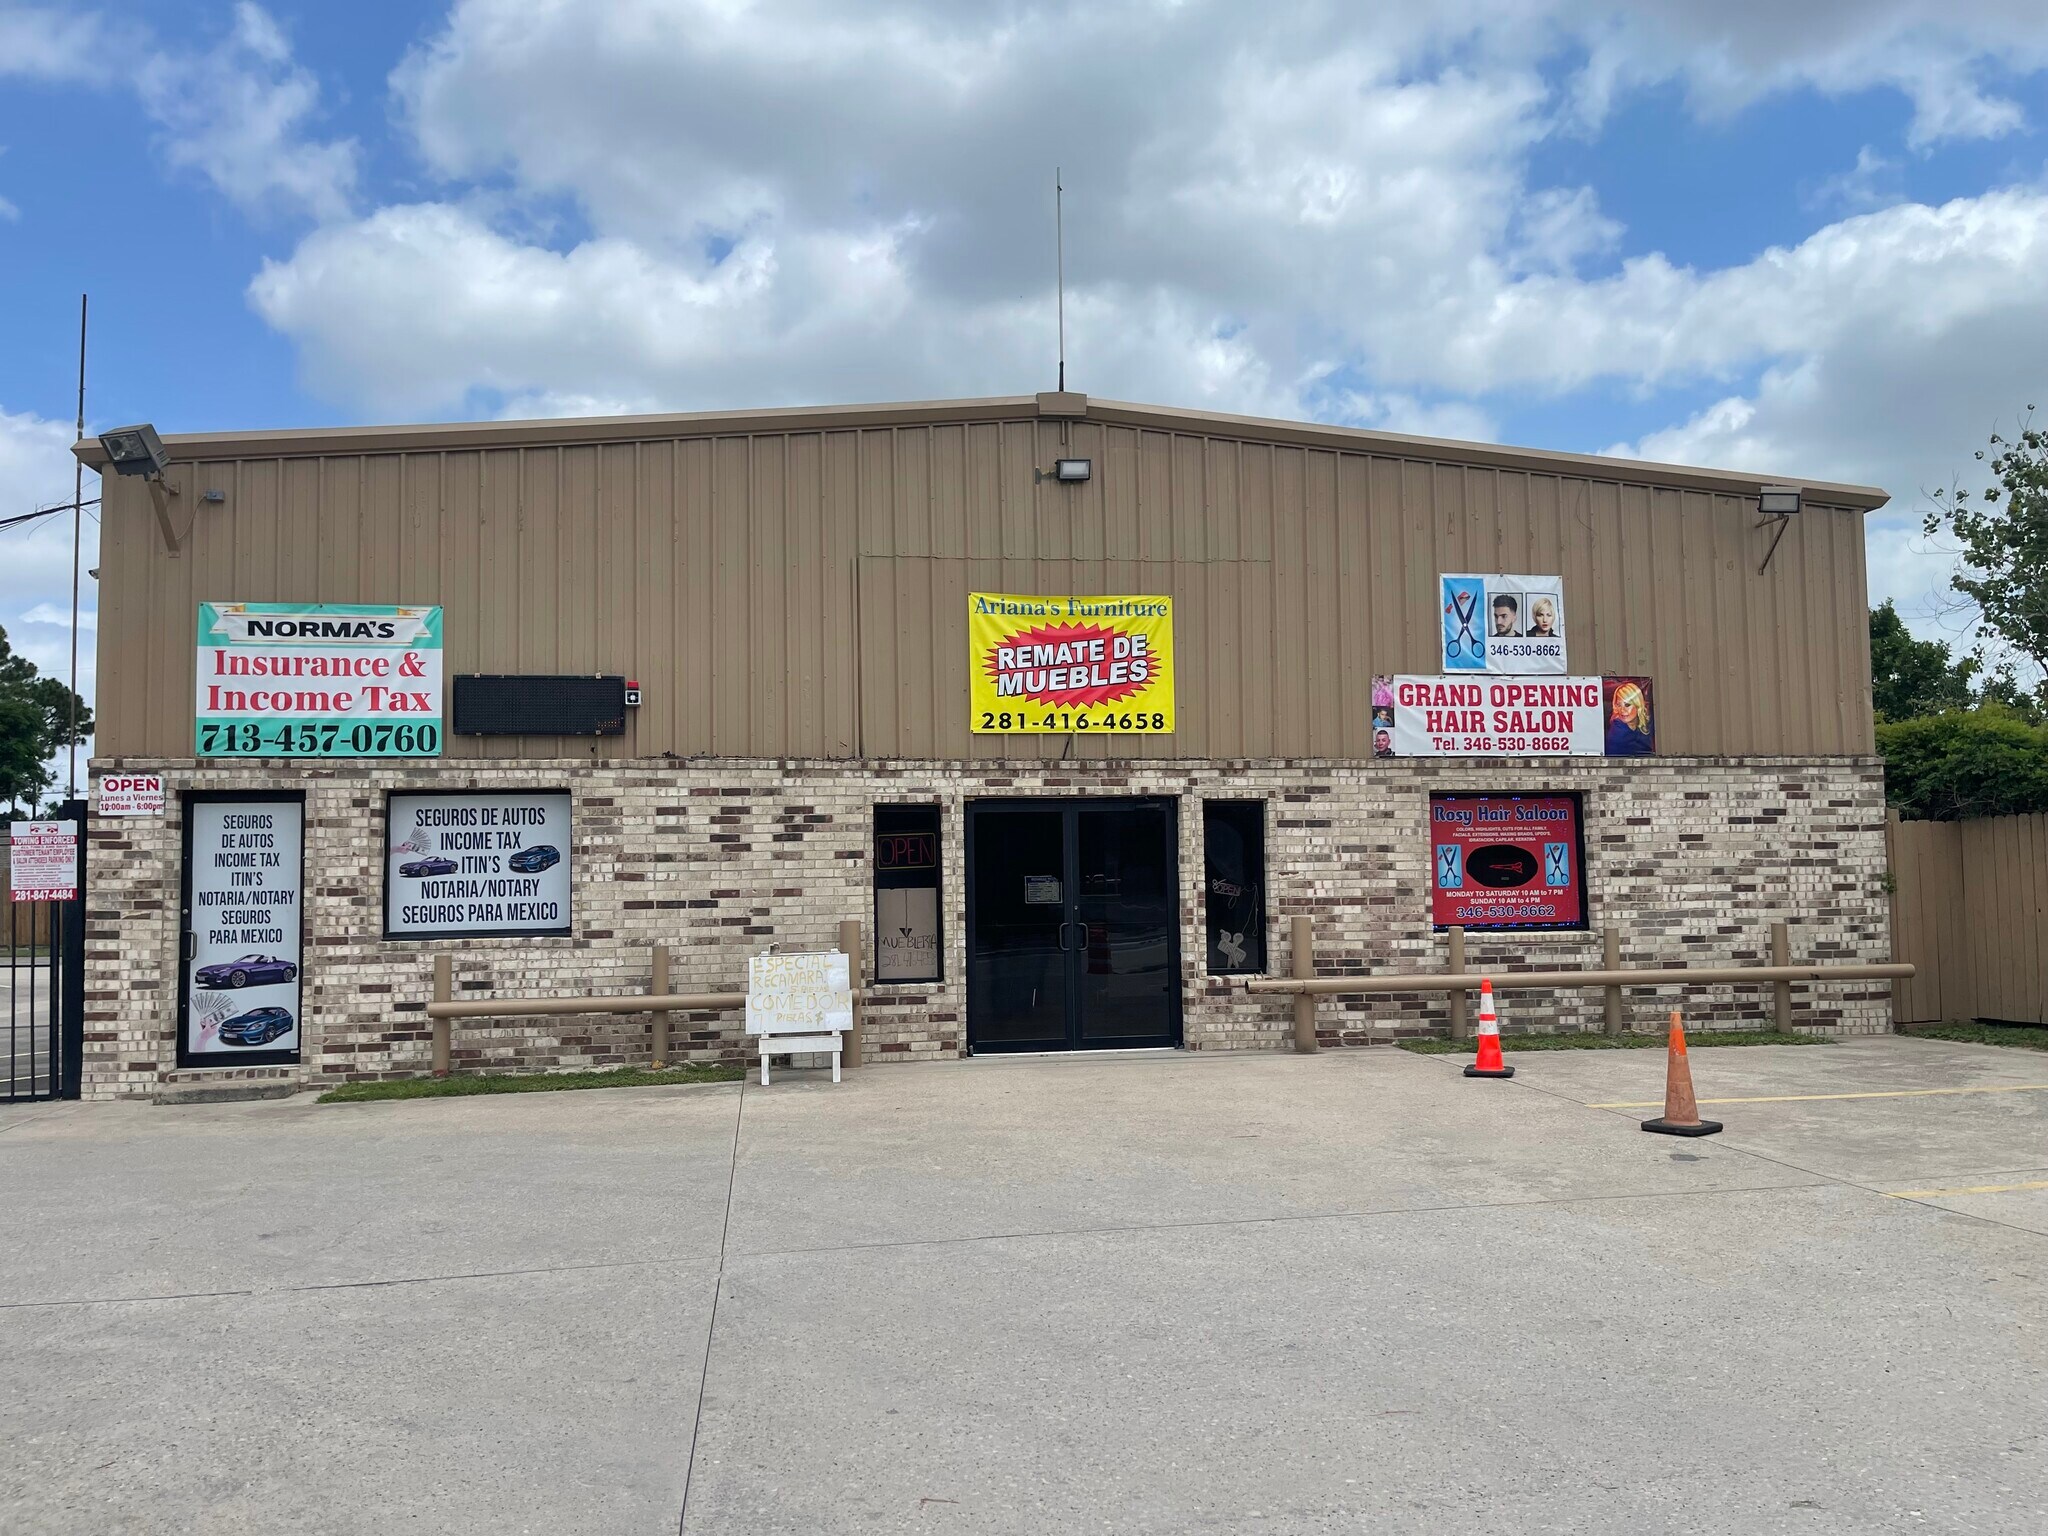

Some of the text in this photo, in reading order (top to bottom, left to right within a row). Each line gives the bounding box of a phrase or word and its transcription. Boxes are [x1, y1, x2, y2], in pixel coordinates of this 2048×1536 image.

[974, 596, 1168, 618] Ariana's Furniture
[247, 620, 395, 639] NORMA'S
[997, 634, 1148, 671] REMATE DE
[1490, 644, 1560, 656] 346-530-8662
[214, 650, 427, 678] Insurance &
[997, 659, 1148, 697] MUEBLES
[206, 685, 432, 712] Income Tax
[1400, 684, 1598, 708] GRAND OPENING
[982, 713, 1164, 730] 281-416-4658
[1426, 711, 1574, 733] HAIR SALON
[200, 723, 437, 753] 713-457-0760
[1432, 738, 1569, 750] Tel. 346-530-8662
[104, 779, 159, 792] OPEN
[223, 815, 273, 829] SEGUROS
[416, 808, 546, 826] SEGUROS DE AUTOS
[1434, 804, 1568, 826] Rosy Hair Saloon
[13, 836, 75, 845] TOWING ENFORCED
[222, 834, 274, 848] DE AUTOS
[440, 832, 522, 850] INCOME TAX
[214, 852, 280, 867] INCOME TAX
[880, 837, 934, 865] OPEN
[462, 856, 500, 874] ITIN'S
[232, 872, 262, 886] ITIN'S
[14, 890, 73, 900] 281-847-4484
[422, 878, 540, 900] NOTARIA/NOTARY
[198, 891, 294, 906] NOTARIA/NOTARY
[222, 910, 271, 924] SEGUROS
[402, 902, 558, 924] SEGUROS PARA MEXICO
[1456, 905, 1555, 918] 346-530-8662
[209, 929, 282, 944] PARA MEXICO
[754, 955, 833, 974] ESPECIAL
[751, 994, 849, 1012] COMEDOR
